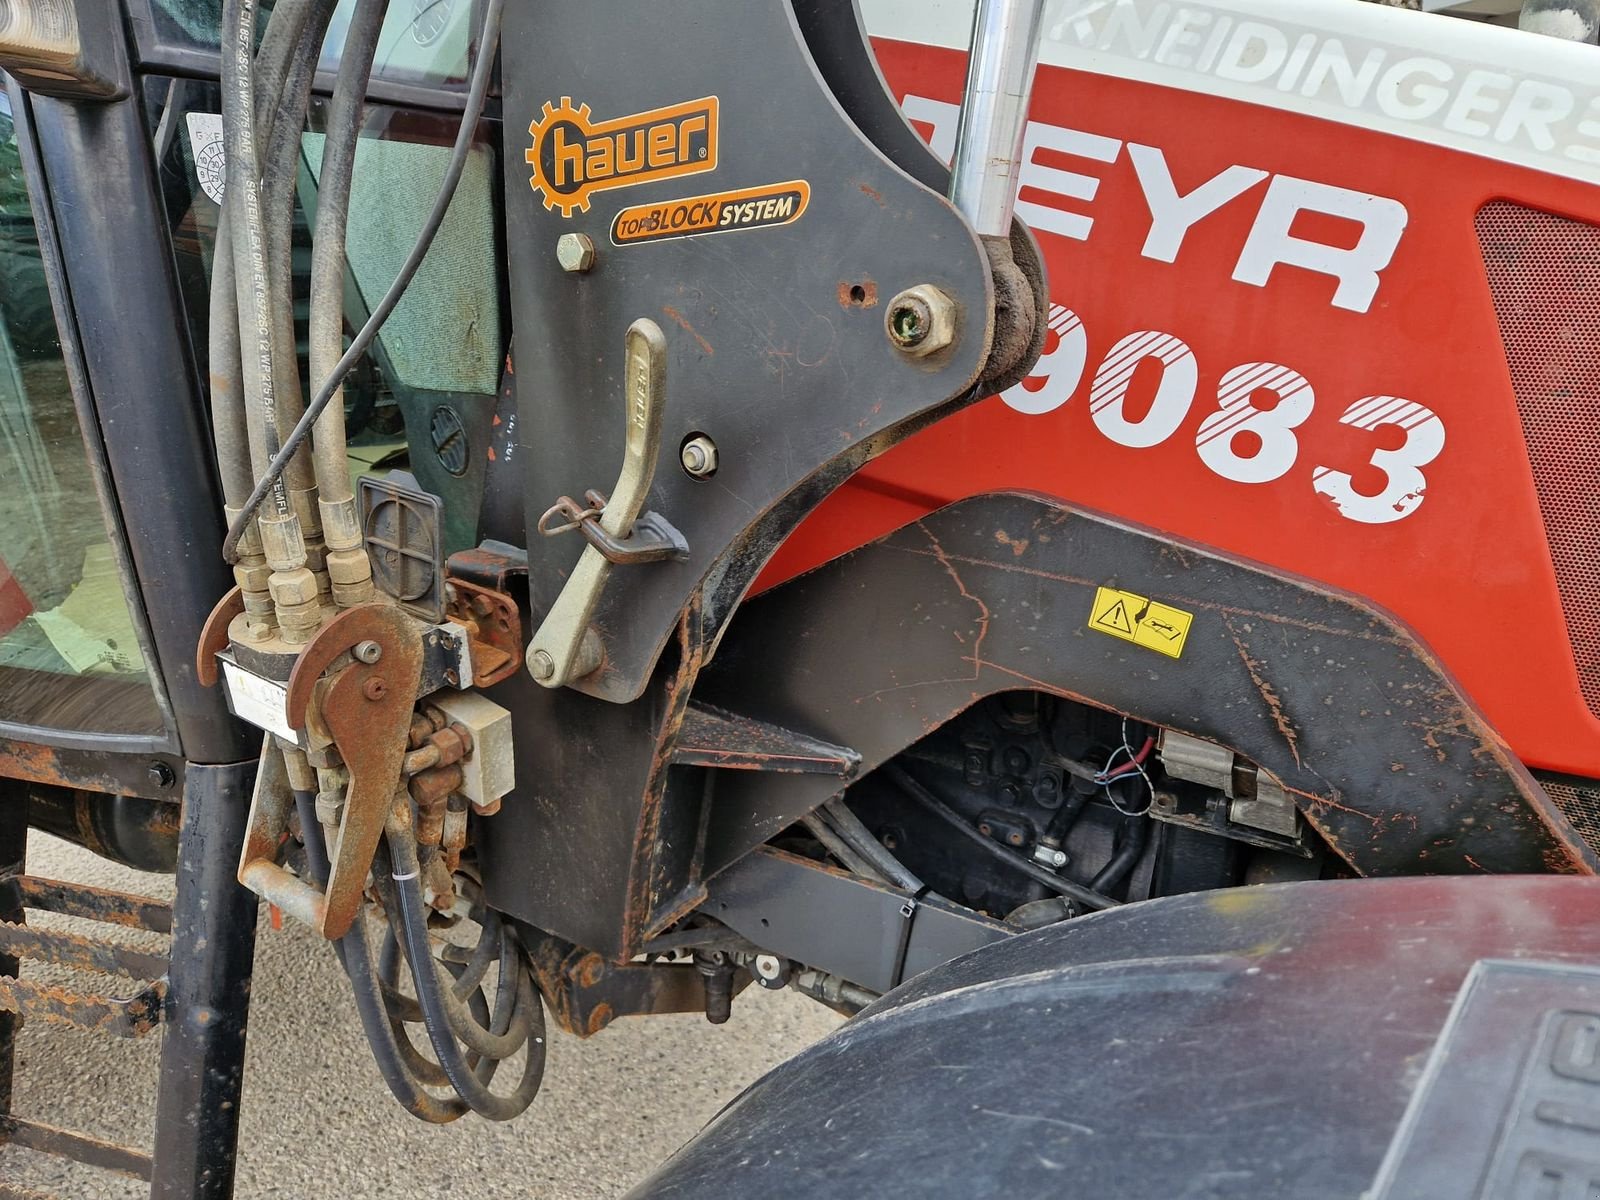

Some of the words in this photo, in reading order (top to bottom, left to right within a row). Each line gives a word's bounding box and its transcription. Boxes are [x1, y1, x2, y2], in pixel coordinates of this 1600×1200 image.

[239, 75, 249, 88] 12
[239, 90, 249, 108] WP
[241, 131, 252, 154] BAR
[553, 115, 706, 186] hauer
[246, 180, 262, 250] SYSTEMFLEX
[720, 196, 794, 227] SYSTEM
[1000, 302, 1446, 524] 9083
